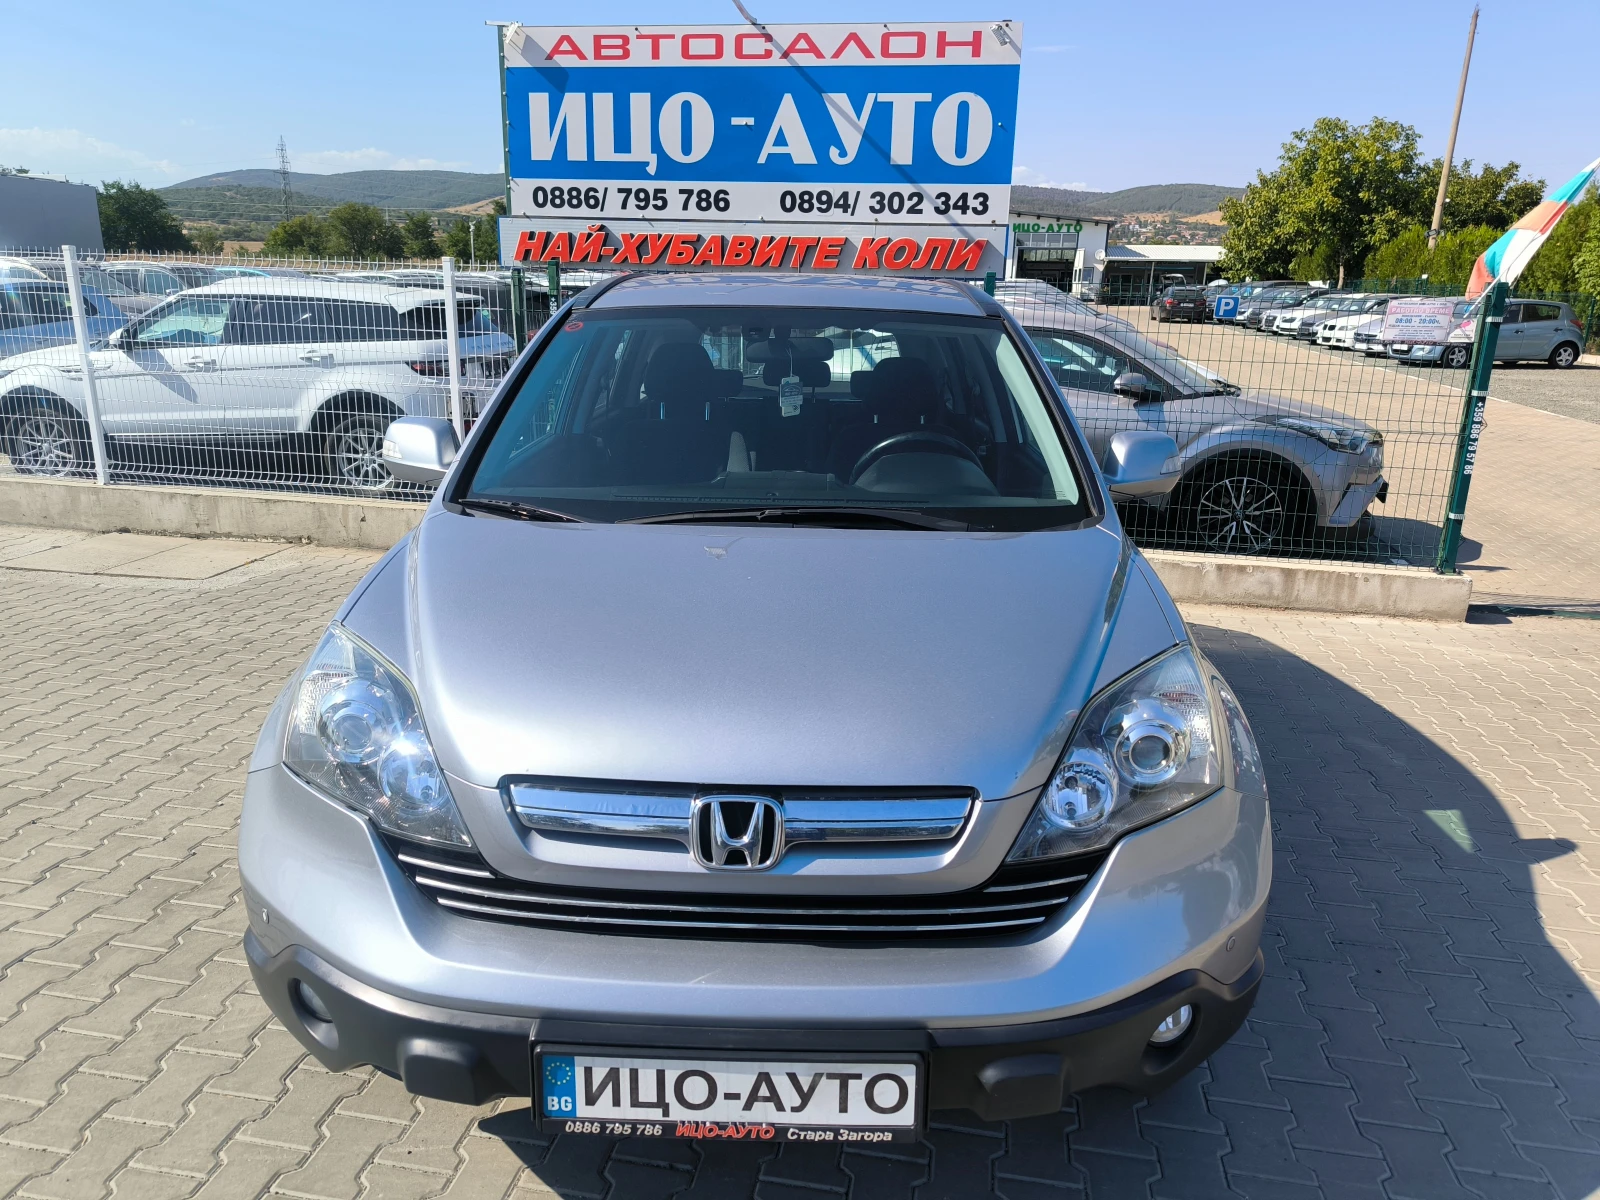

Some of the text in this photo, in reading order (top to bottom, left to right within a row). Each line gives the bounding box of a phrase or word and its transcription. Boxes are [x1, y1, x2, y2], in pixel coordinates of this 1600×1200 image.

[545, 31, 983, 61] АВТОСАЛОН
[532, 186, 731, 212] 0886/ 795 786
[780, 190, 989, 216] 0894/ 302 343
[1013, 223, 1083, 233] ИЦО-АУТО
[513, 224, 988, 271] НАЙ-ХУБАВИТЕ КОЛИ
[1219, 298, 1235, 316] P
[1464, 402, 1484, 475] +359 886 79 57 86
[583, 1066, 909, 1118] ИЦО-АУТО
[547, 1096, 573, 1112] BG
[565, 1121, 662, 1136] 0886 795 786
[675, 1121, 775, 1139] ИЦО-АУТО
[787, 1127, 893, 1143] Стара Загора
